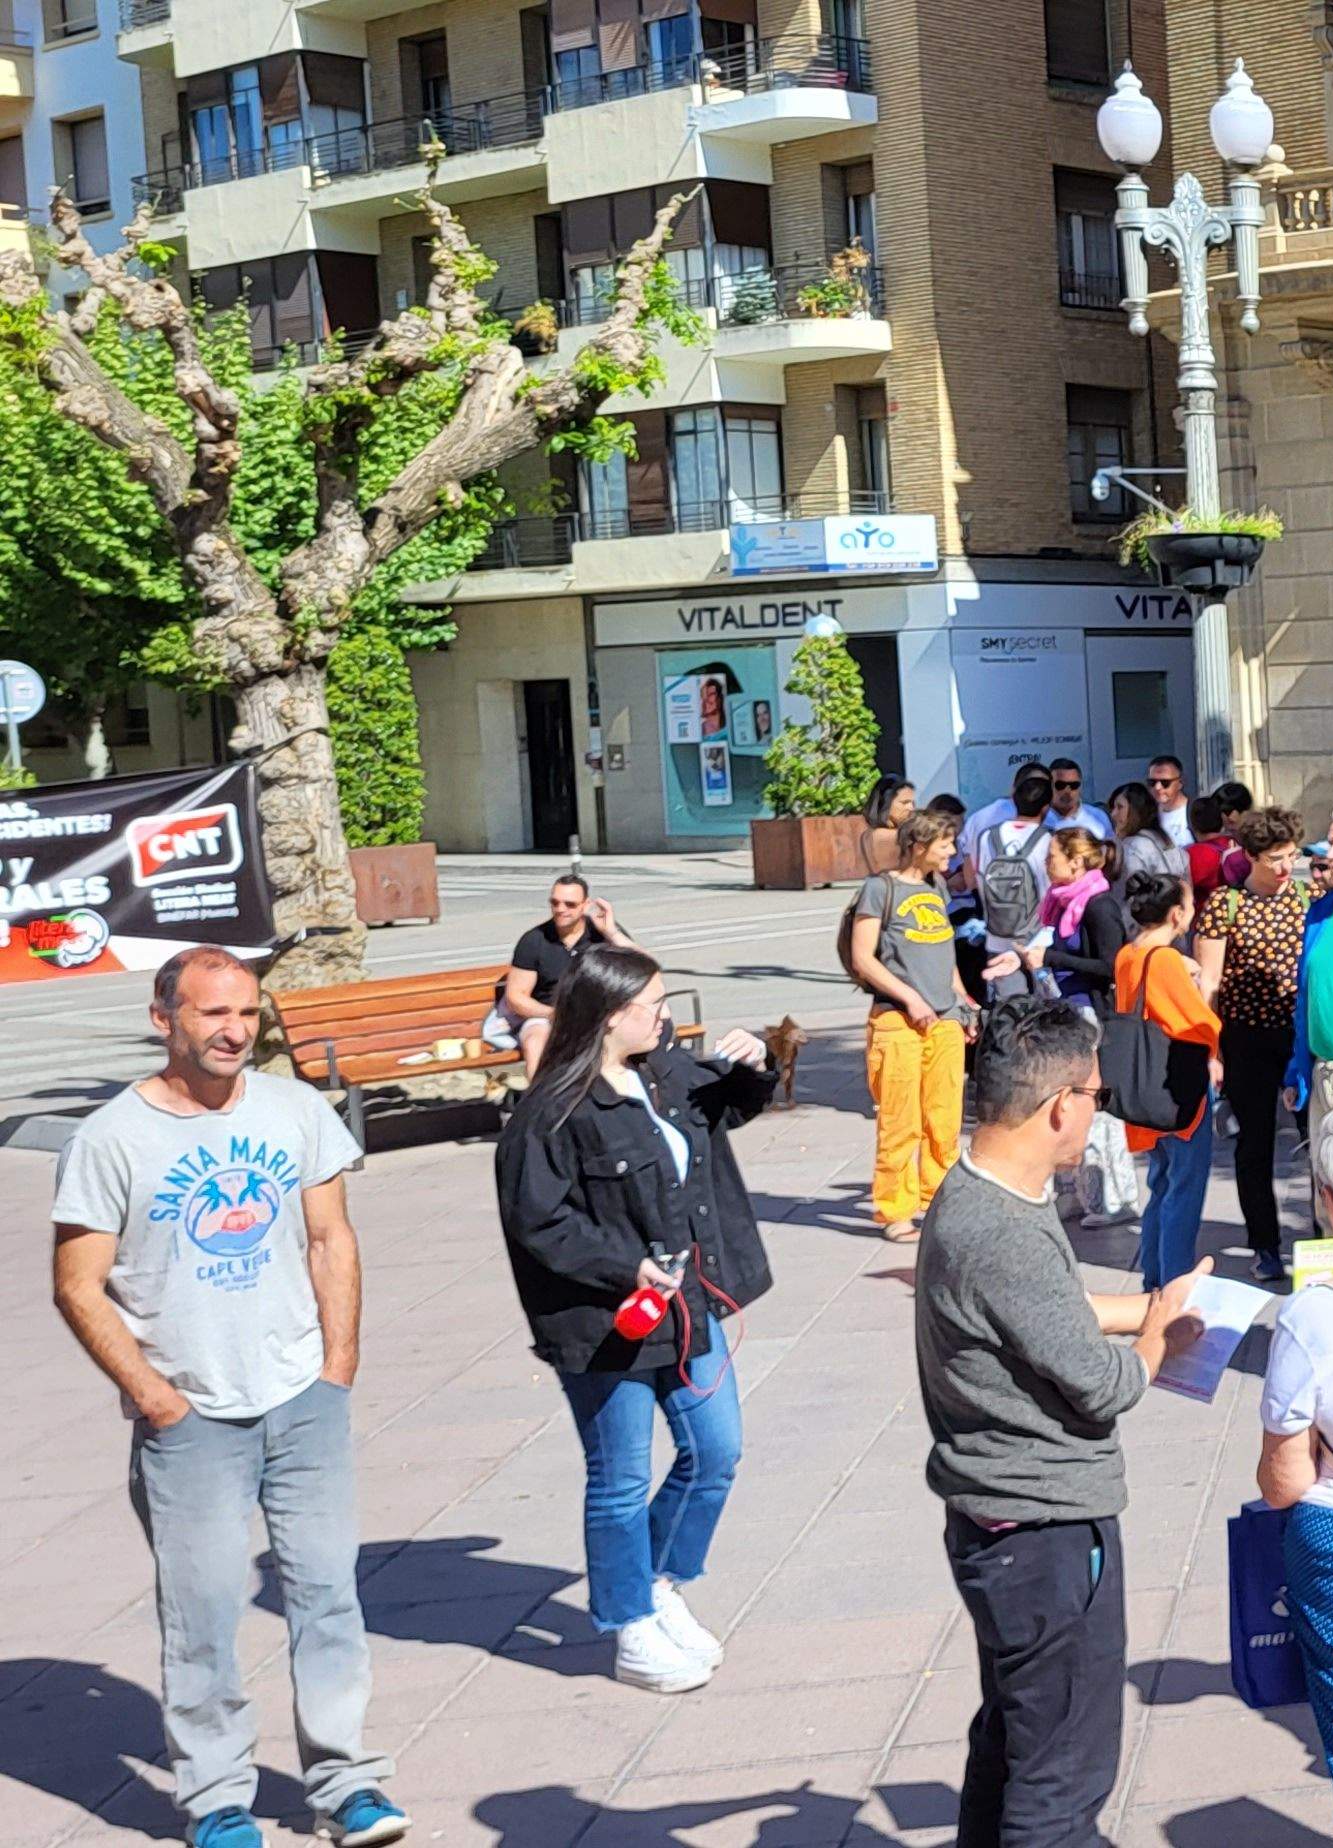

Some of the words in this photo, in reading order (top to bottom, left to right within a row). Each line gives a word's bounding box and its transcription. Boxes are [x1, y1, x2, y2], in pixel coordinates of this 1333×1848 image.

[677, 598, 844, 632] VITALDENT
[148, 826, 222, 862] CNT
[149, 1144, 220, 1222] SANTA
[229, 1134, 300, 1196] MARIA
